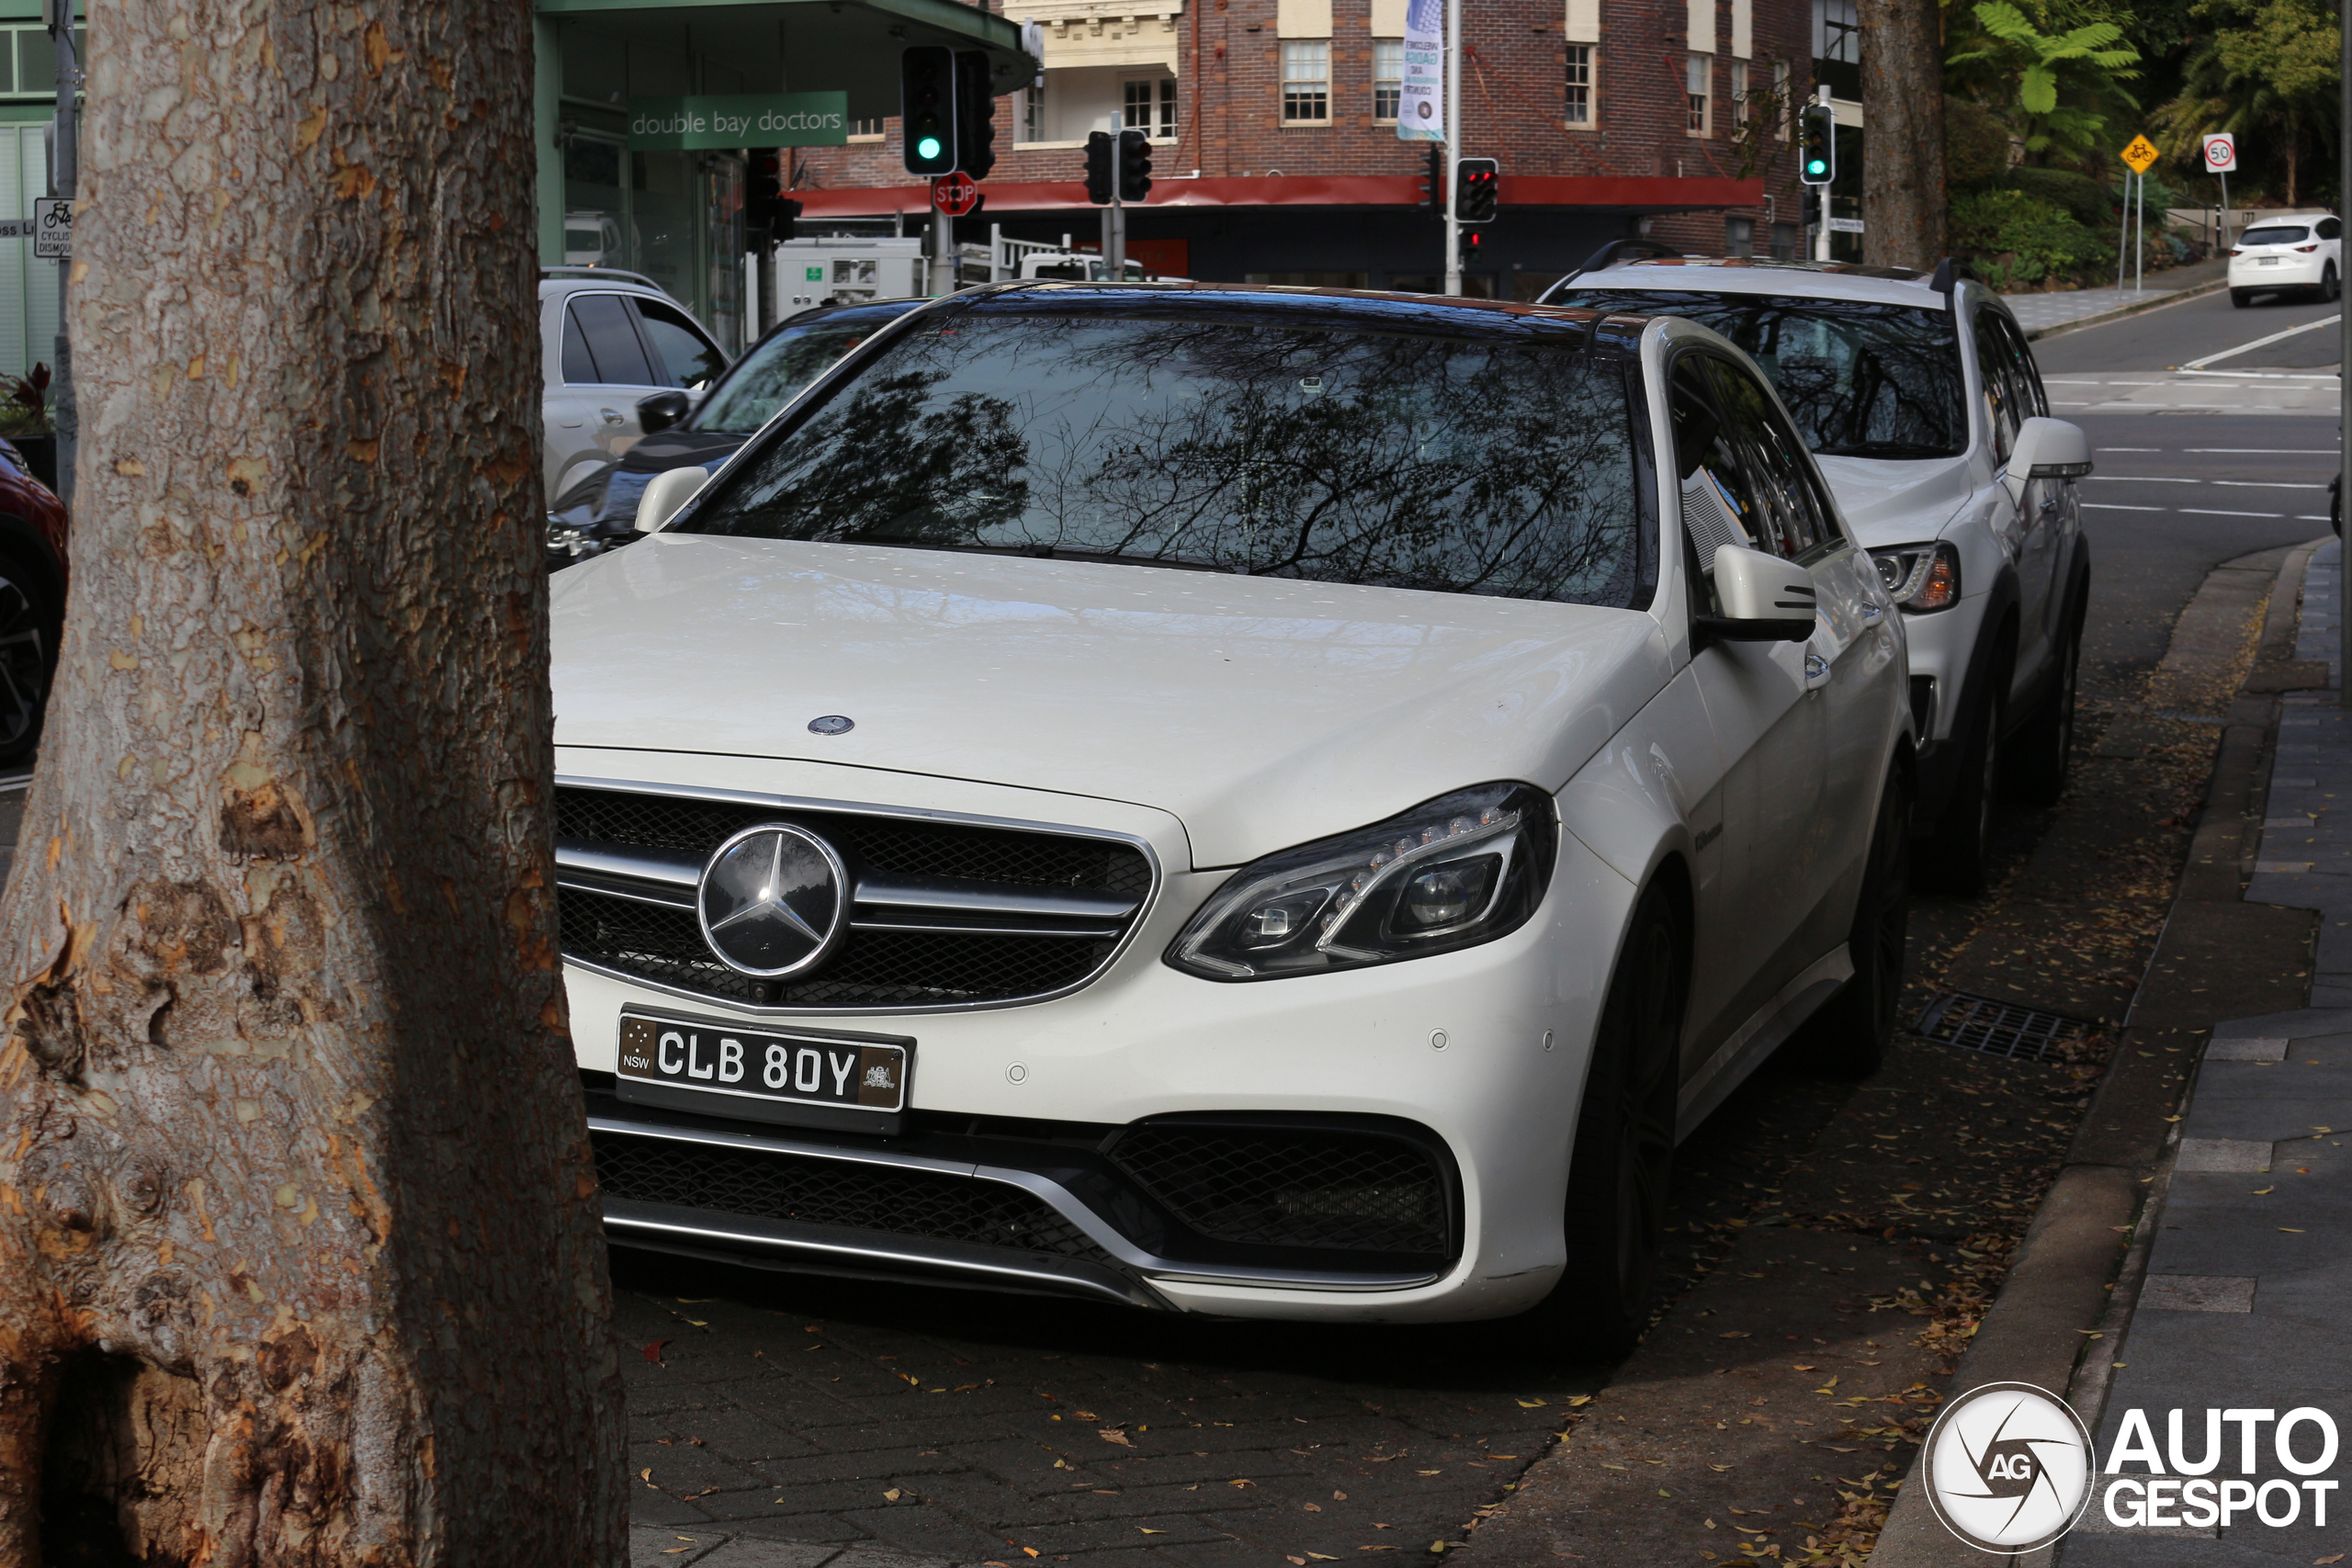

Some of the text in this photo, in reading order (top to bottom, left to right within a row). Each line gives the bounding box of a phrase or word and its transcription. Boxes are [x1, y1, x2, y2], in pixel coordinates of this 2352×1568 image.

[632, 109, 842, 138] double bay doctors
[2211, 146, 2229, 160] 50
[937, 186, 974, 202] STOP
[2242, 211, 2255, 224] 177
[0, 226, 17, 236] ss
[41, 231, 72, 241] CYCLIS
[40, 243, 72, 253] DISMOU
[623, 1055, 650, 1070] NSW
[657, 1031, 745, 1083] CLB
